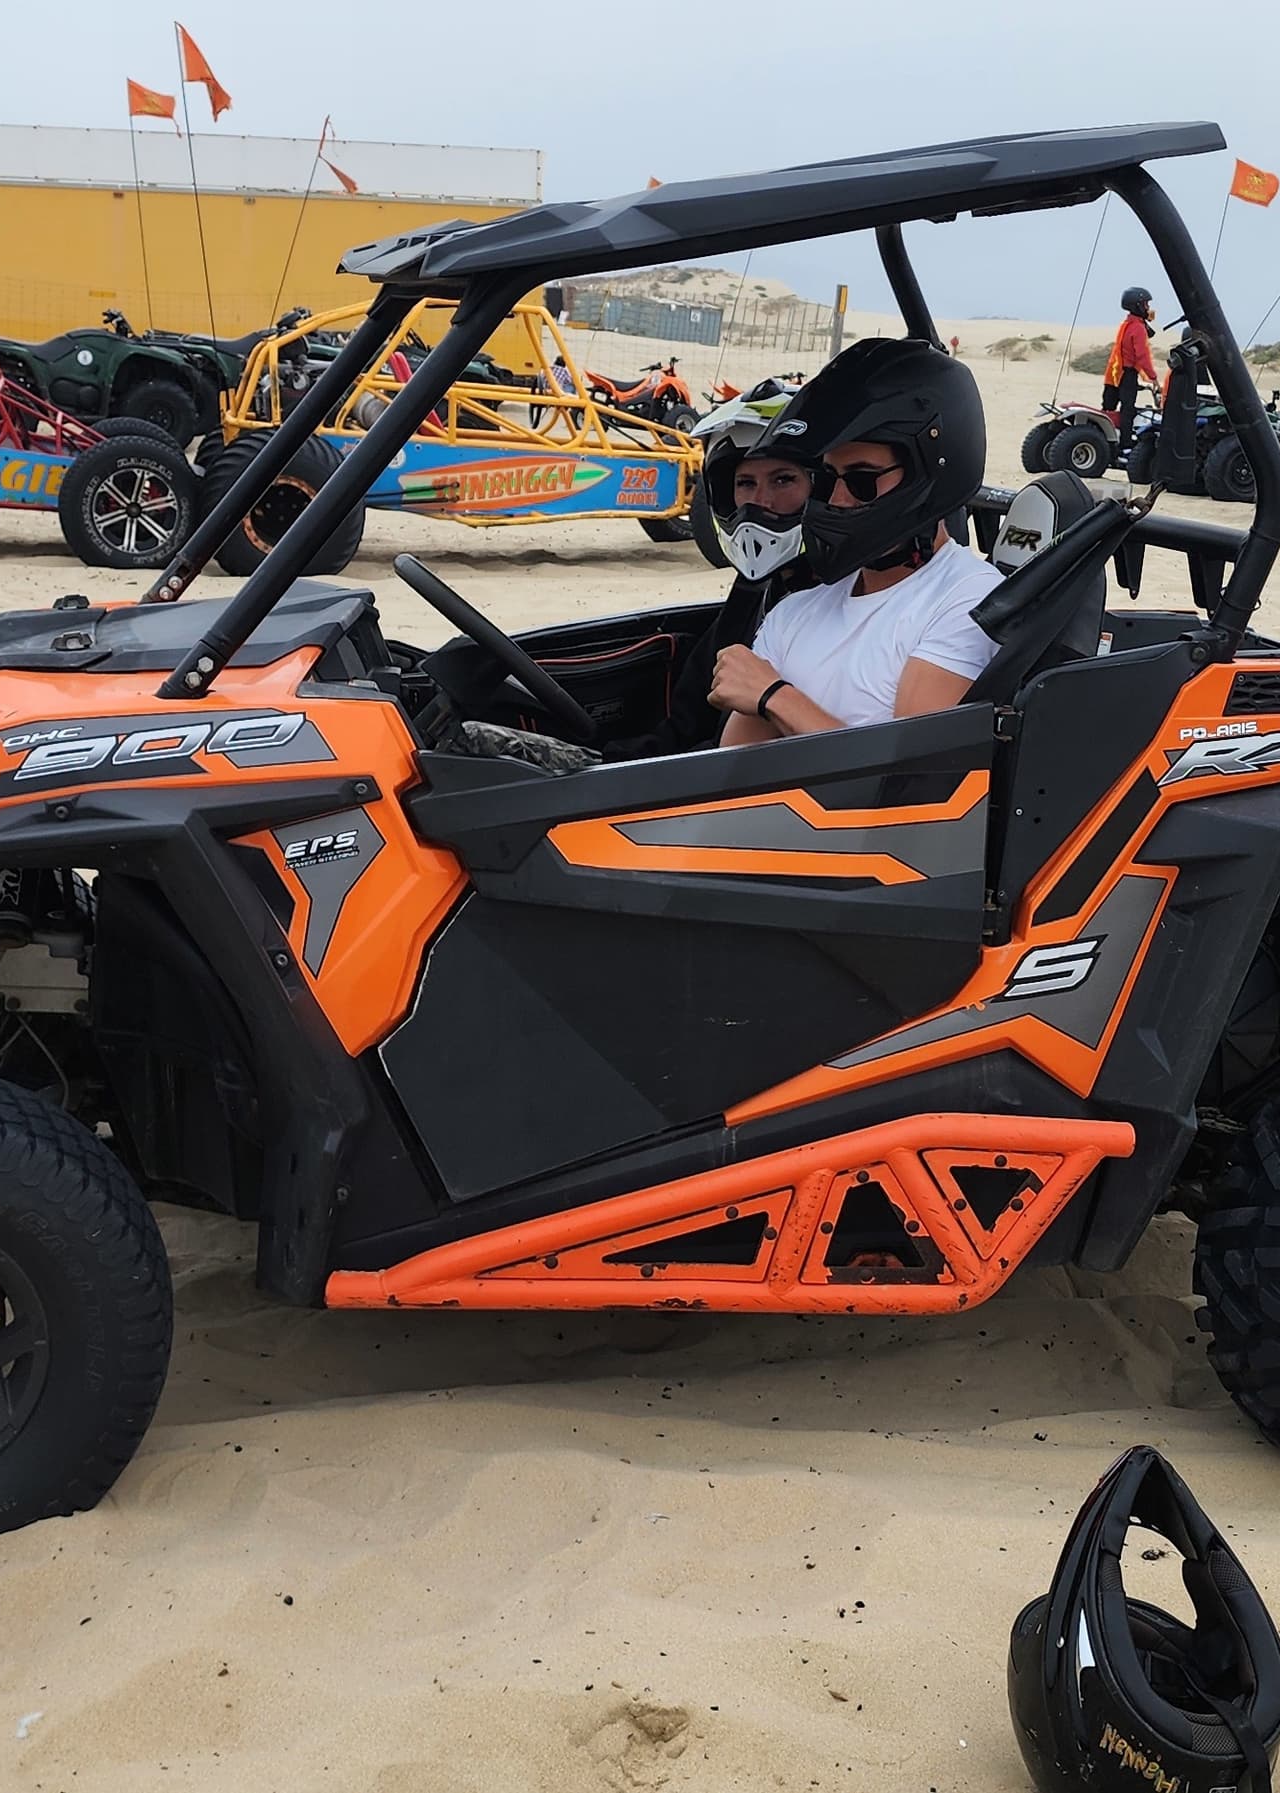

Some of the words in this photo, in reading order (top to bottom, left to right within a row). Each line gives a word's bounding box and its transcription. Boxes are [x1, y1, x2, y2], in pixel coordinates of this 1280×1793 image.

[1000, 525, 1042, 551] RZR
[13, 712, 307, 781] 900
[285, 830, 358, 859] EPS
[1006, 937, 1100, 998] S
